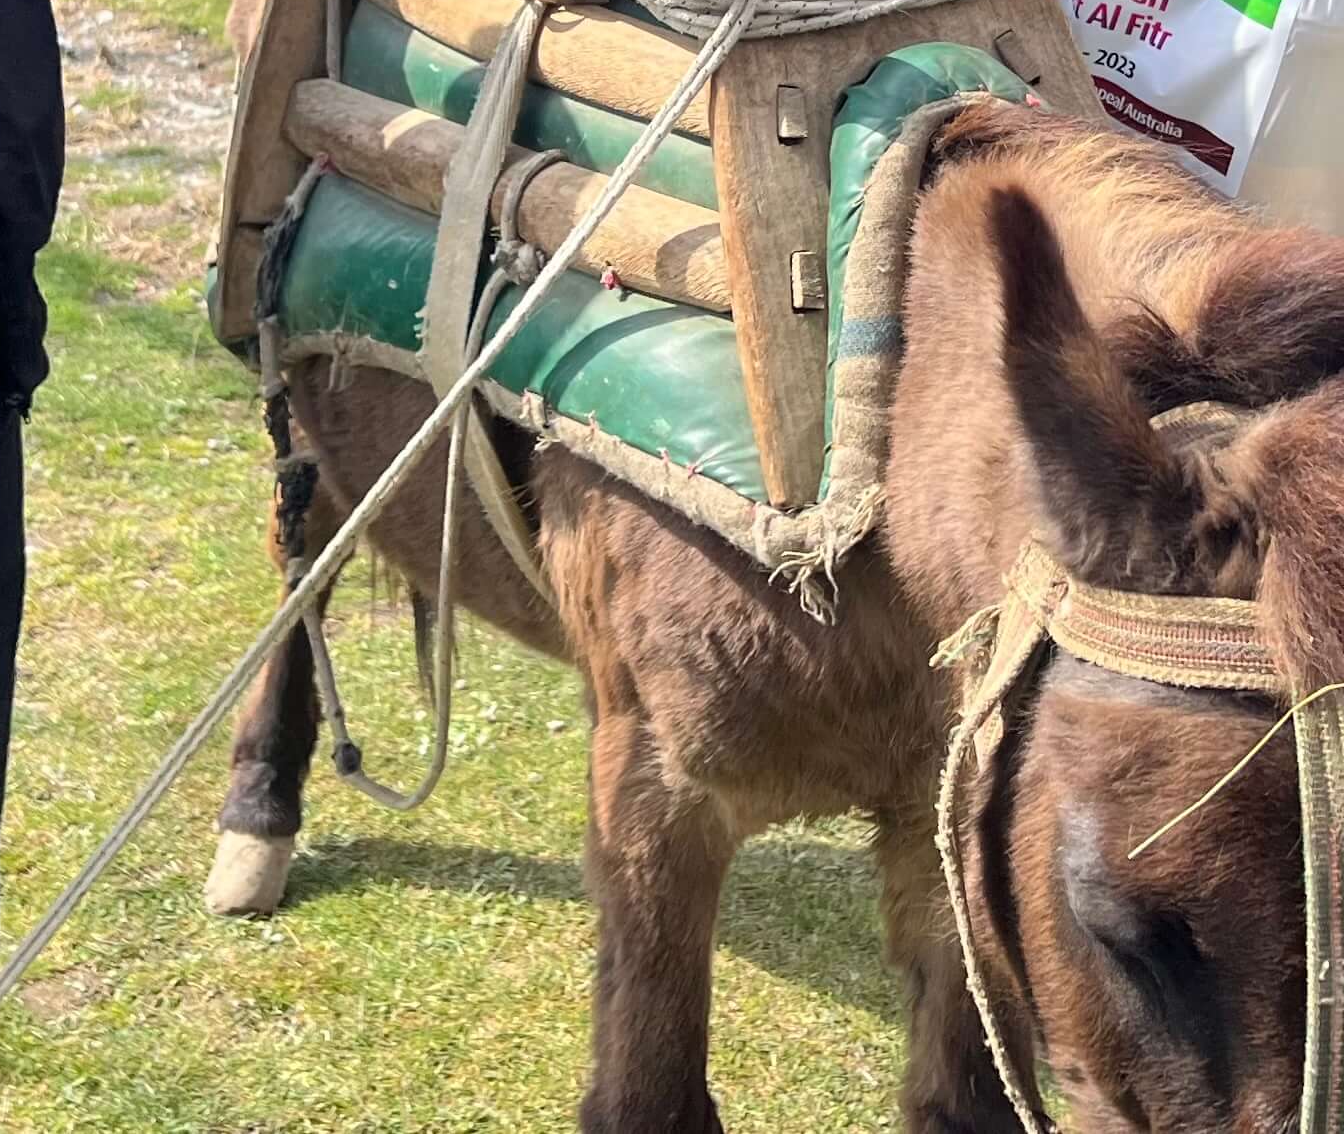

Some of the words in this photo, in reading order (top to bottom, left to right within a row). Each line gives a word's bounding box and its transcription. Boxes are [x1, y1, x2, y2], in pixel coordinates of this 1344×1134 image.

[1086, 2, 1122, 31] Al
[1125, 13, 1173, 50] Fitr
[1094, 49, 1137, 79] 2023
[1124, 103, 1184, 139] Australia
